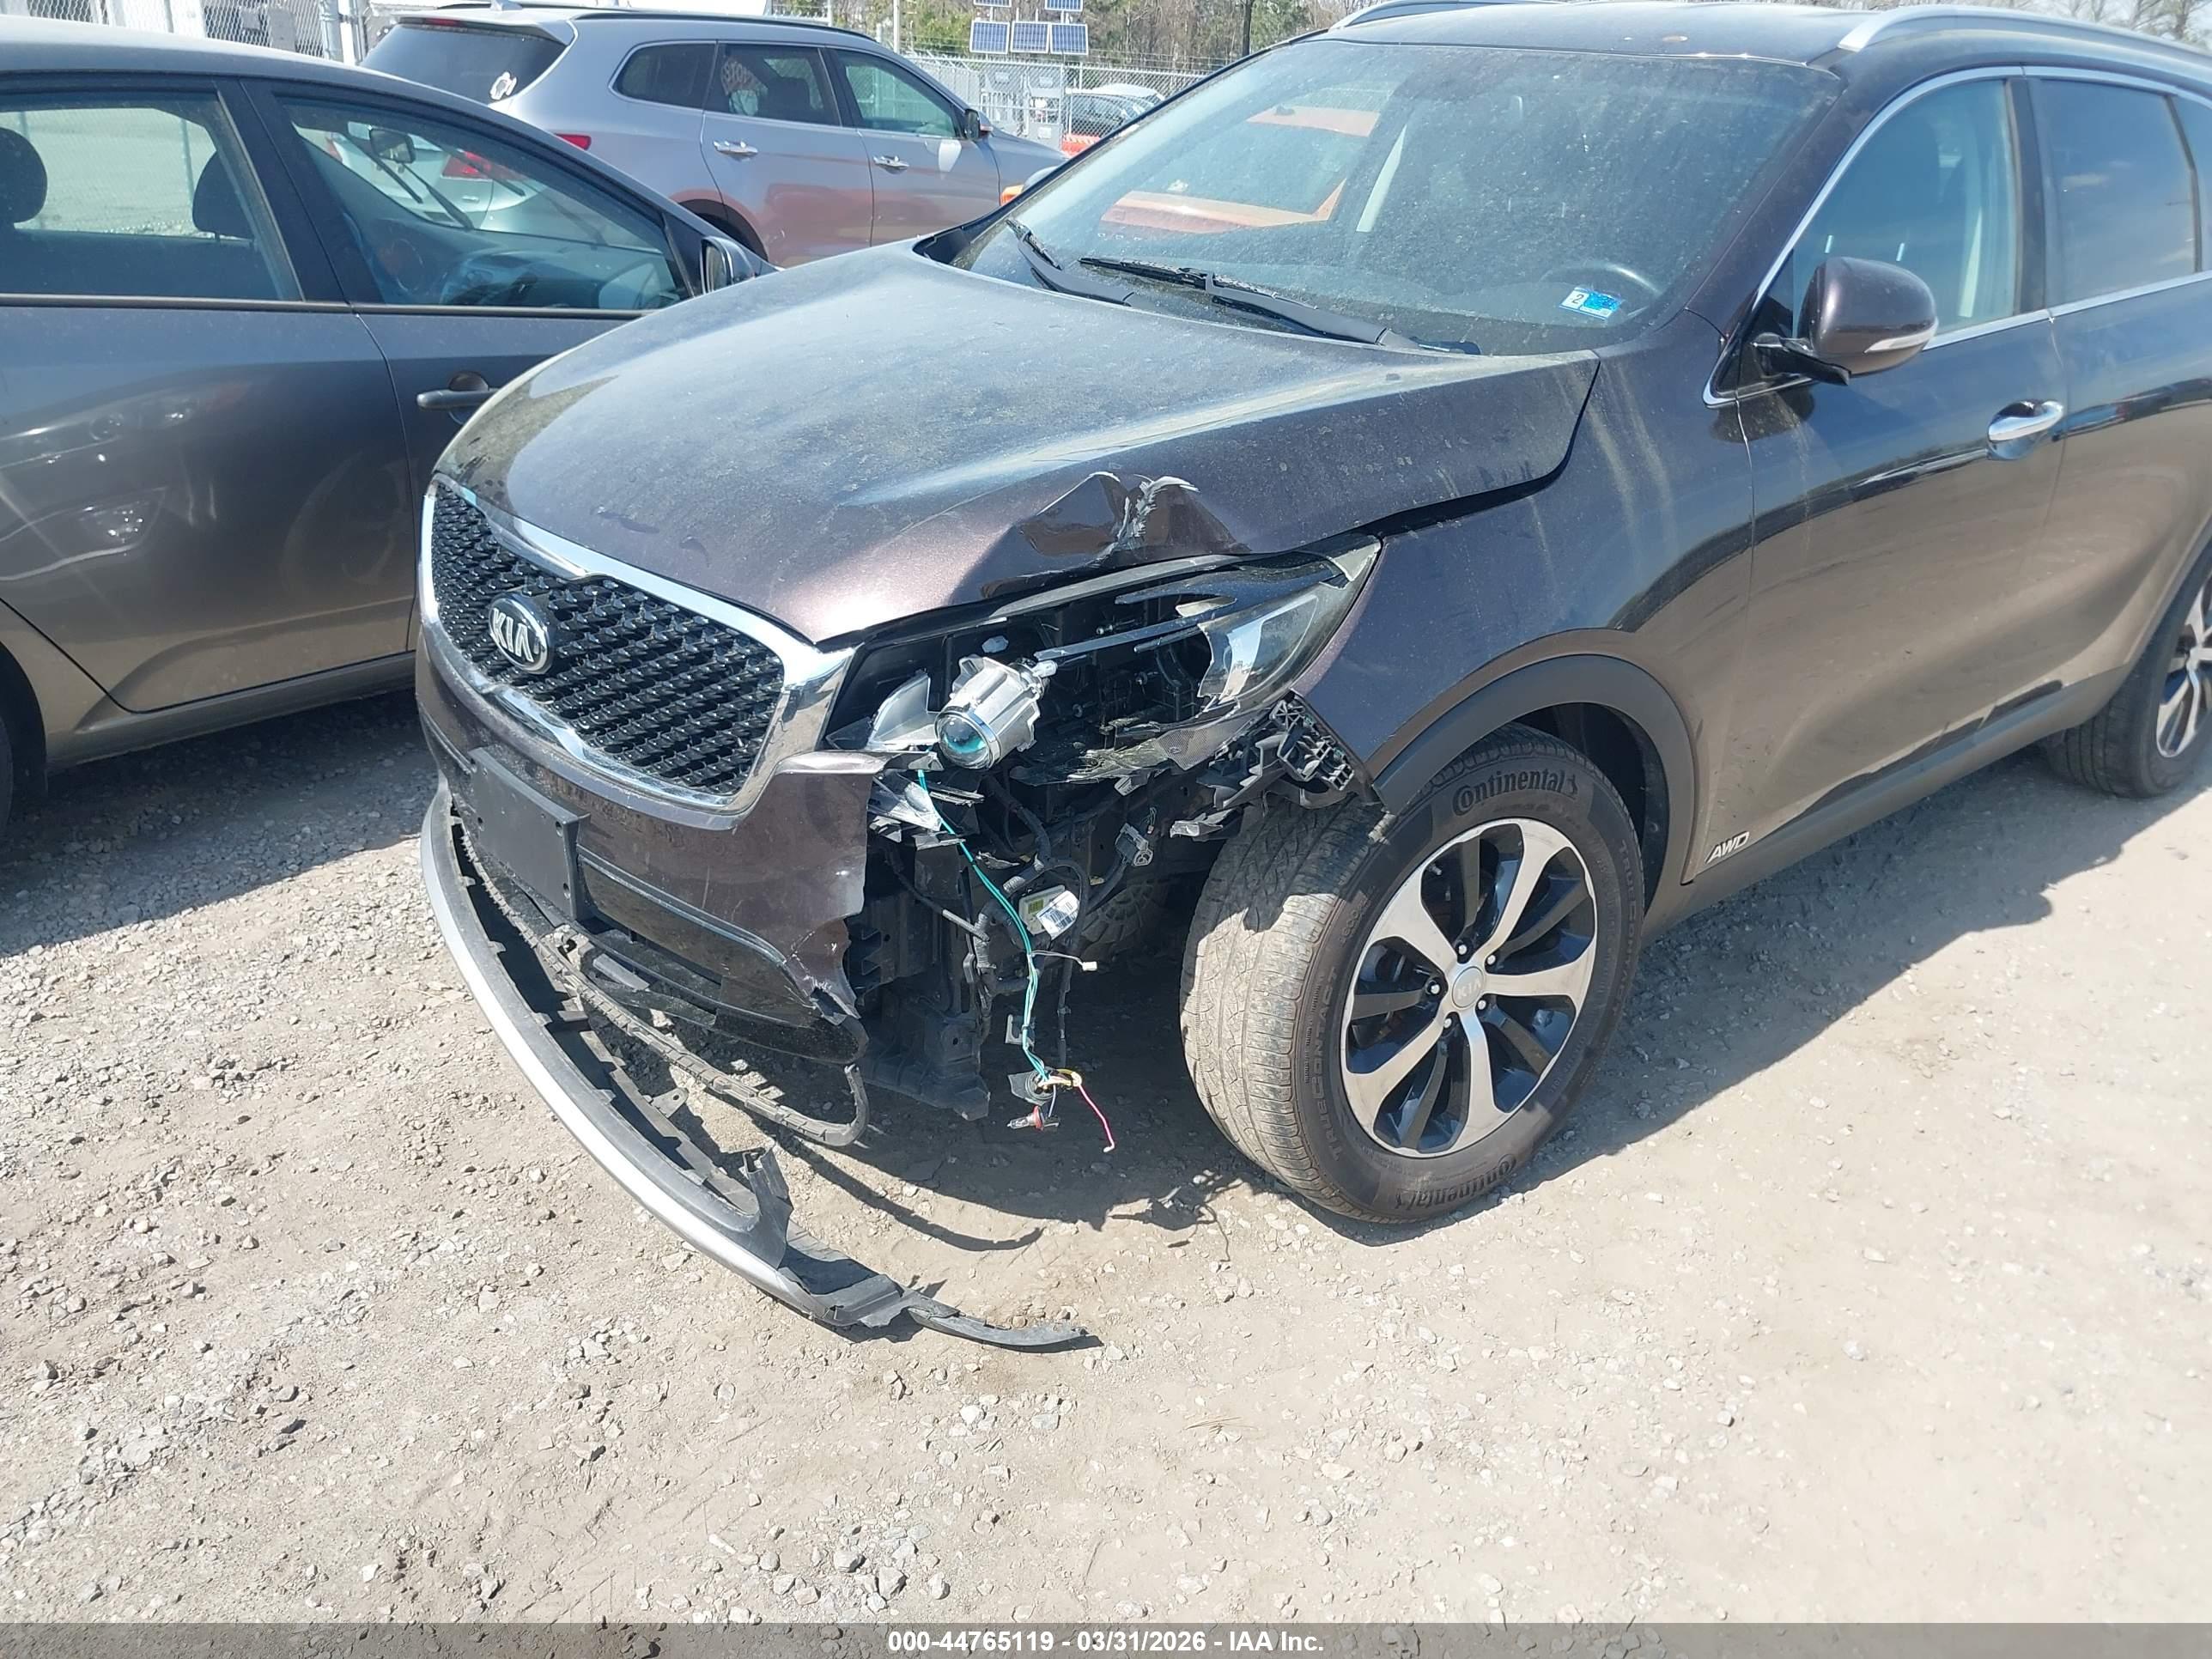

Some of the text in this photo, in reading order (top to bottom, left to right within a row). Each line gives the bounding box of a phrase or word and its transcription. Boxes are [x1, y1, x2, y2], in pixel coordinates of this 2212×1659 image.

[493, 607, 535, 662] KIA
[1452, 769, 1566, 816] Continental
[1705, 831, 1750, 864] AWD
[1456, 979, 1481, 1000] KIA
